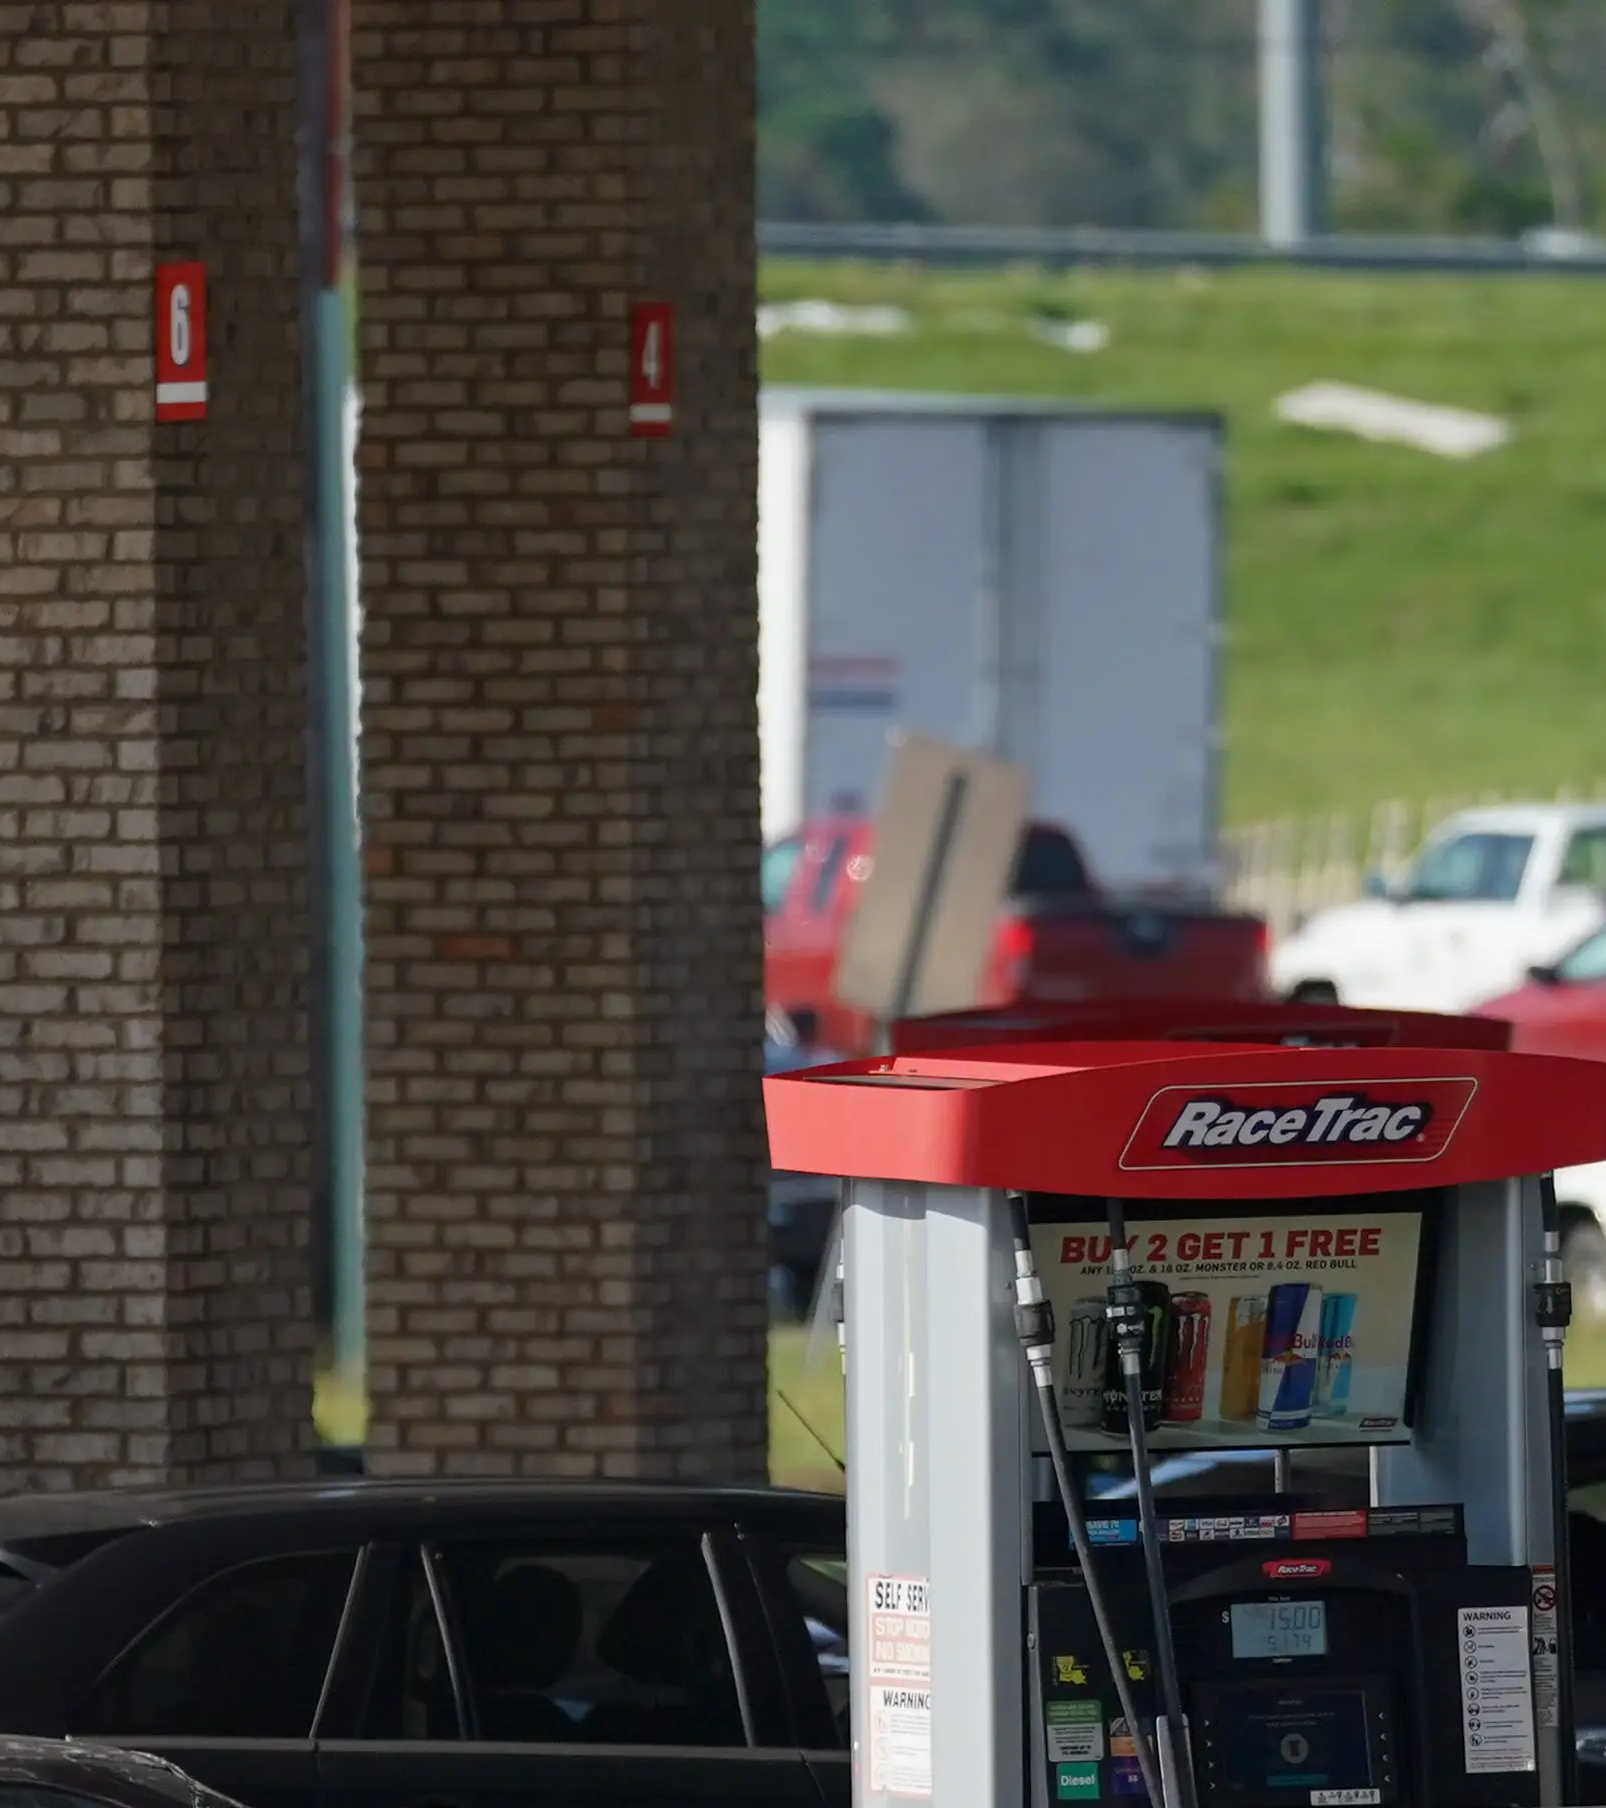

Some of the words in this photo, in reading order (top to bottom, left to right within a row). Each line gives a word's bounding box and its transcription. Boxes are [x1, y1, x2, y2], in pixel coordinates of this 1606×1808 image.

[169, 281, 191, 366] 6
[639, 320, 661, 391] 4
[1162, 1097, 1423, 1148] RaceTrac
[1146, 1233, 1169, 1262] 2
[1176, 1231, 1251, 1261] GET
[1257, 1230, 1276, 1258] 1
[1285, 1227, 1383, 1258] FREE
[1080, 1265, 1103, 1276] ANY
[1195, 1261, 1248, 1273] MONSTER
[1250, 1261, 1264, 1271] OR
[1305, 1259, 1327, 1270] RED
[1329, 1258, 1358, 1270] BULL
[875, 1581, 902, 1611] SELF
[1462, 1610, 1512, 1623] WARNING
[1060, 1774, 1096, 1787] Diesel
